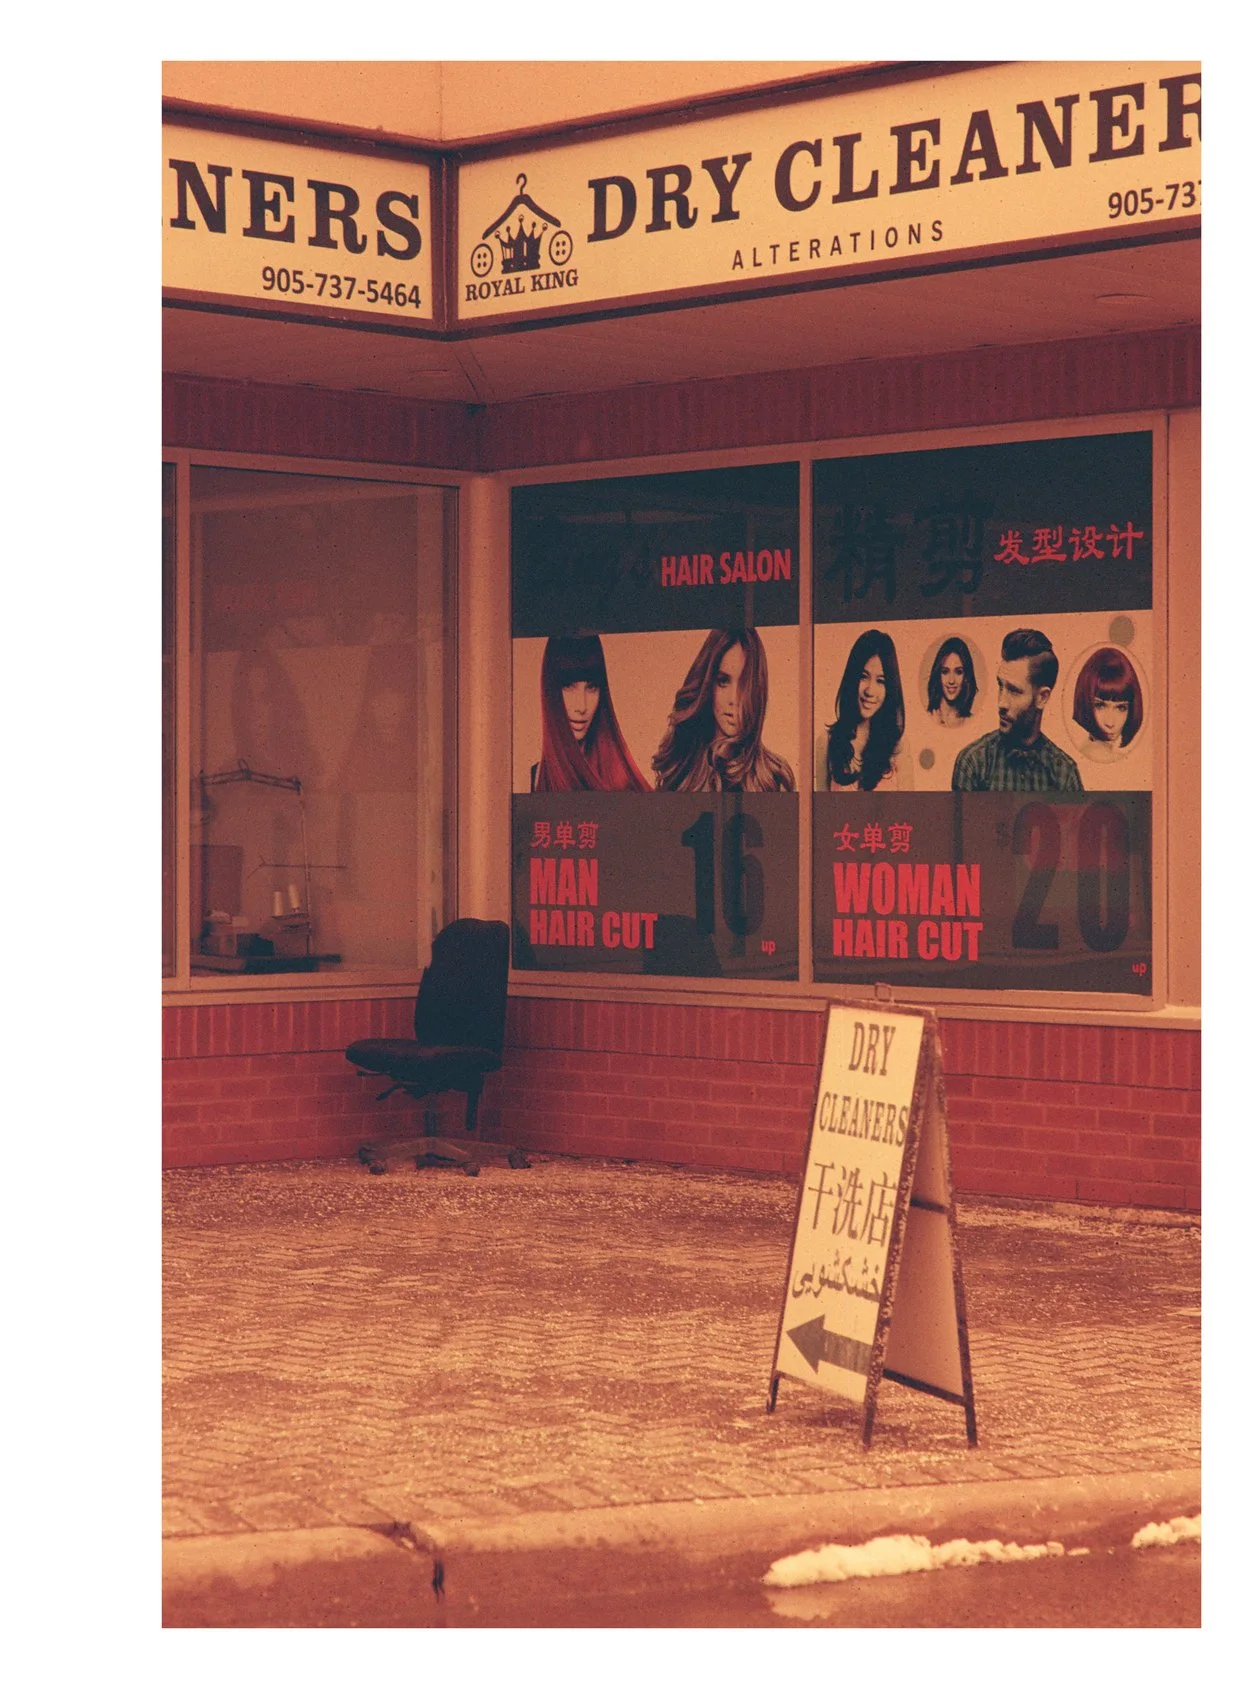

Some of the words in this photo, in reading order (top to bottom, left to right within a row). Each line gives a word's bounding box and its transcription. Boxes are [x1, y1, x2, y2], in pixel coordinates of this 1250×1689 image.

[587, 152, 753, 244] DRY
[1108, 180, 1201, 219] 905-73
[732, 219, 945, 271] ALTERATIONS
[261, 266, 422, 309] 905-737-5464
[465, 277, 526, 302] ROYAL
[530, 268, 580, 293] KING
[994, 521, 1144, 566] 发型设计
[661, 554, 713, 587] HAIR
[719, 548, 791, 584] SALON
[531, 820, 599, 850] 男单剪
[832, 821, 914, 854] 女单剪
[529, 857, 599, 907] MAN
[682, 811, 766, 937] 16
[832, 861, 982, 917] WOMAN
[529, 908, 596, 947] HAIR
[601, 911, 659, 950] CUT
[760, 939, 777, 957] up
[832, 917, 909, 959] HAIR
[916, 919, 985, 962] CUT
[1131, 962, 1148, 977] up
[848, 1021, 896, 1077] DRY
[818, 1091, 910, 1147] CLEANERS
[808, 1161, 899, 1248] 干洗店
